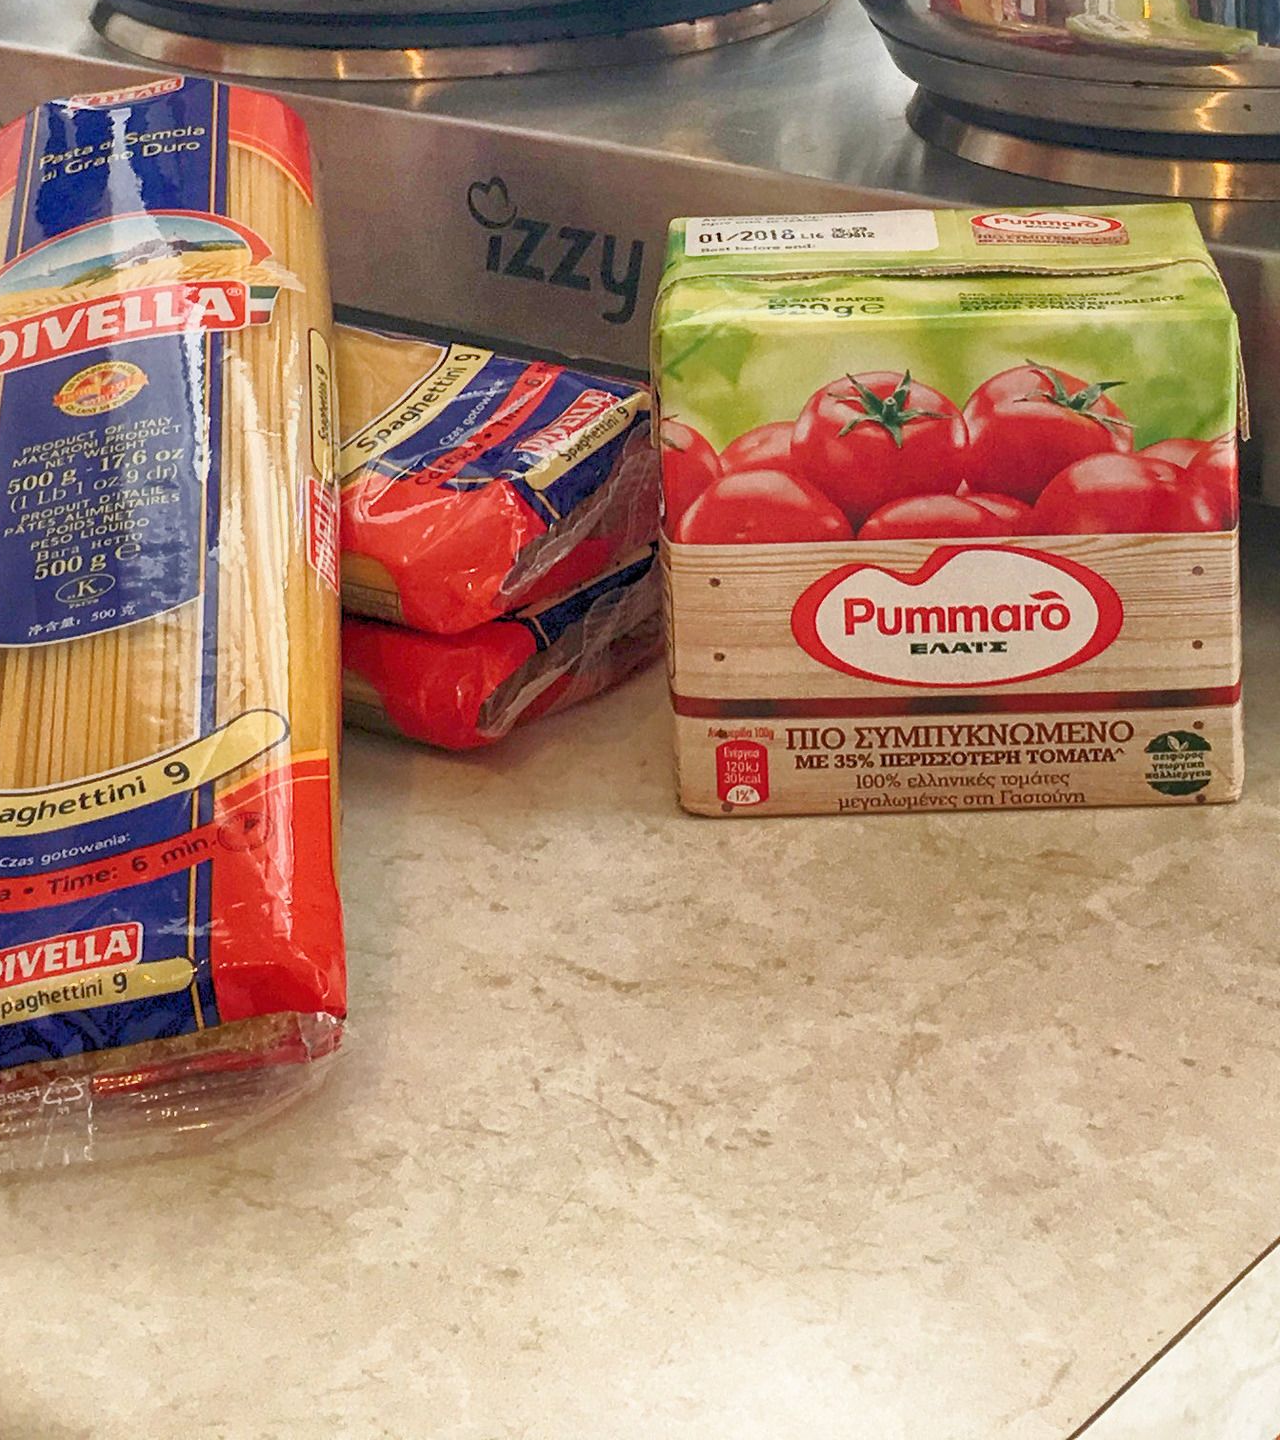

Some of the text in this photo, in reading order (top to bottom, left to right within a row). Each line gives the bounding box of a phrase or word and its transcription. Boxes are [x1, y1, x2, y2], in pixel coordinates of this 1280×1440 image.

[38, 145, 94, 170] Pasta
[124, 125, 206, 146] Semola
[41, 140, 200, 183] di Grano Duro
[356, 366, 469, 454] Spaghettini
[453, 352, 481, 362] 9
[11, 423, 183, 469] MACARONI PRODUCT
[22, 415, 174, 457] PRODUCT OF ITALY
[558, 415, 621, 462] Spaghettini
[615, 406, 630, 418] 9
[44, 438, 147, 471] NET WEIGHT
[6, 469, 55, 496] 500
[60, 467, 78, 488] g
[154, 447, 186, 462] oz
[37, 486, 68, 506] Lb
[125, 468, 139, 484] 9
[20, 497, 91, 525] PRODUIT
[45, 509, 135, 538] POIDS NET
[63, 491, 181, 523] ALIMENTAIRES
[29, 517, 151, 552] PESO LIQUIDO
[34, 554, 84, 581] 500
[89, 553, 108, 573] g
[89, 608, 117, 622] 500
[785, 720, 1135, 750] ΠΙΟ ΣΥΜΠΥΚΝΩΜΕΝΟ
[162, 760, 192, 786] 9
[794, 753, 830, 770] ΜΕ
[834, 753, 875, 769] 35%
[880, 750, 1021, 768] ΠΕΡΙΣΣΟΤΕΡΗ
[855, 770, 1071, 789] 100% ελληνικές τομάτες
[837, 793, 958, 811] μεγαλωμένες
[40, 831, 132, 867] gotowania:
[47, 866, 119, 896] Time:
[131, 855, 149, 873] 6
[111, 971, 129, 994] 9
